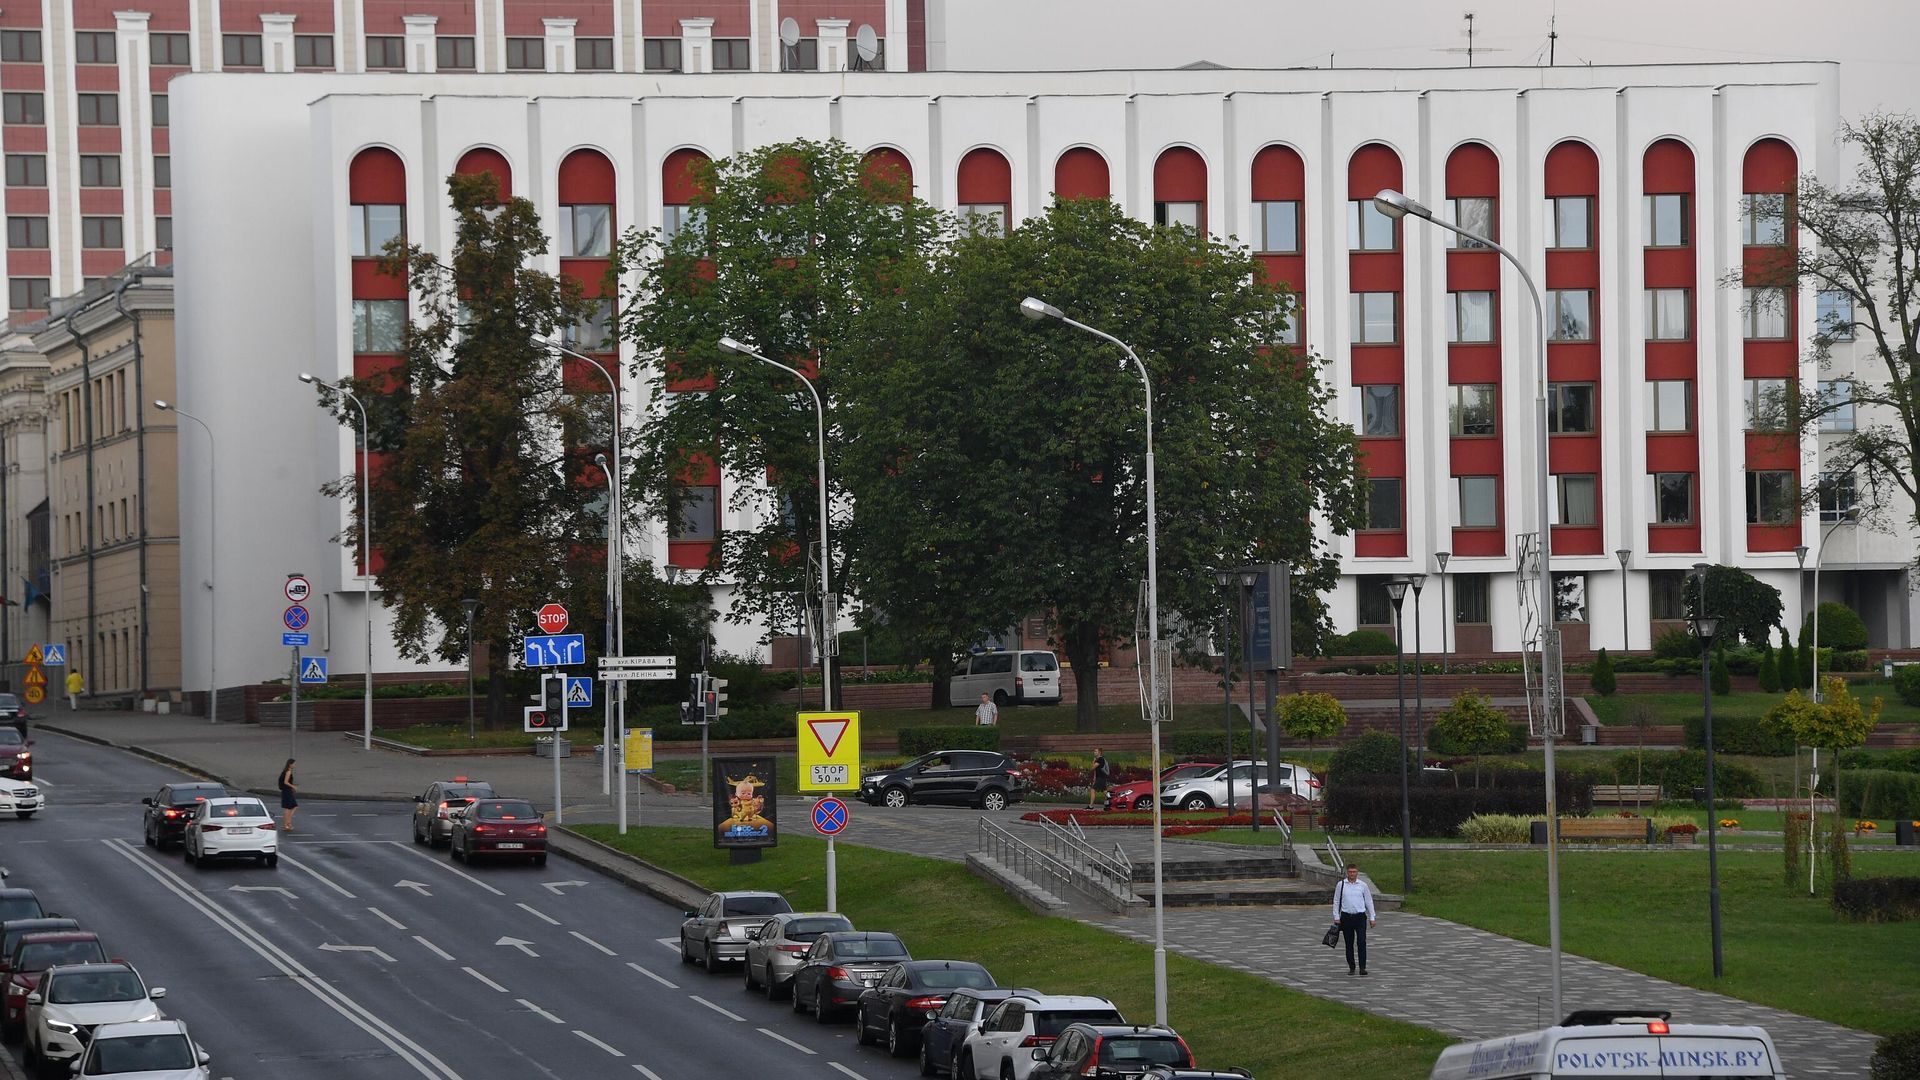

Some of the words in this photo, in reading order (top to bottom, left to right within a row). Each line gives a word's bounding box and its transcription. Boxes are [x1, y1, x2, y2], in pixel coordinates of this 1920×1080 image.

[540, 613, 566, 624] STOP
[814, 766, 844, 774] STOP
[818, 774, 831, 783] 50
[1556, 1050, 1764, 1070] POLOTSK-MINSK.BY
